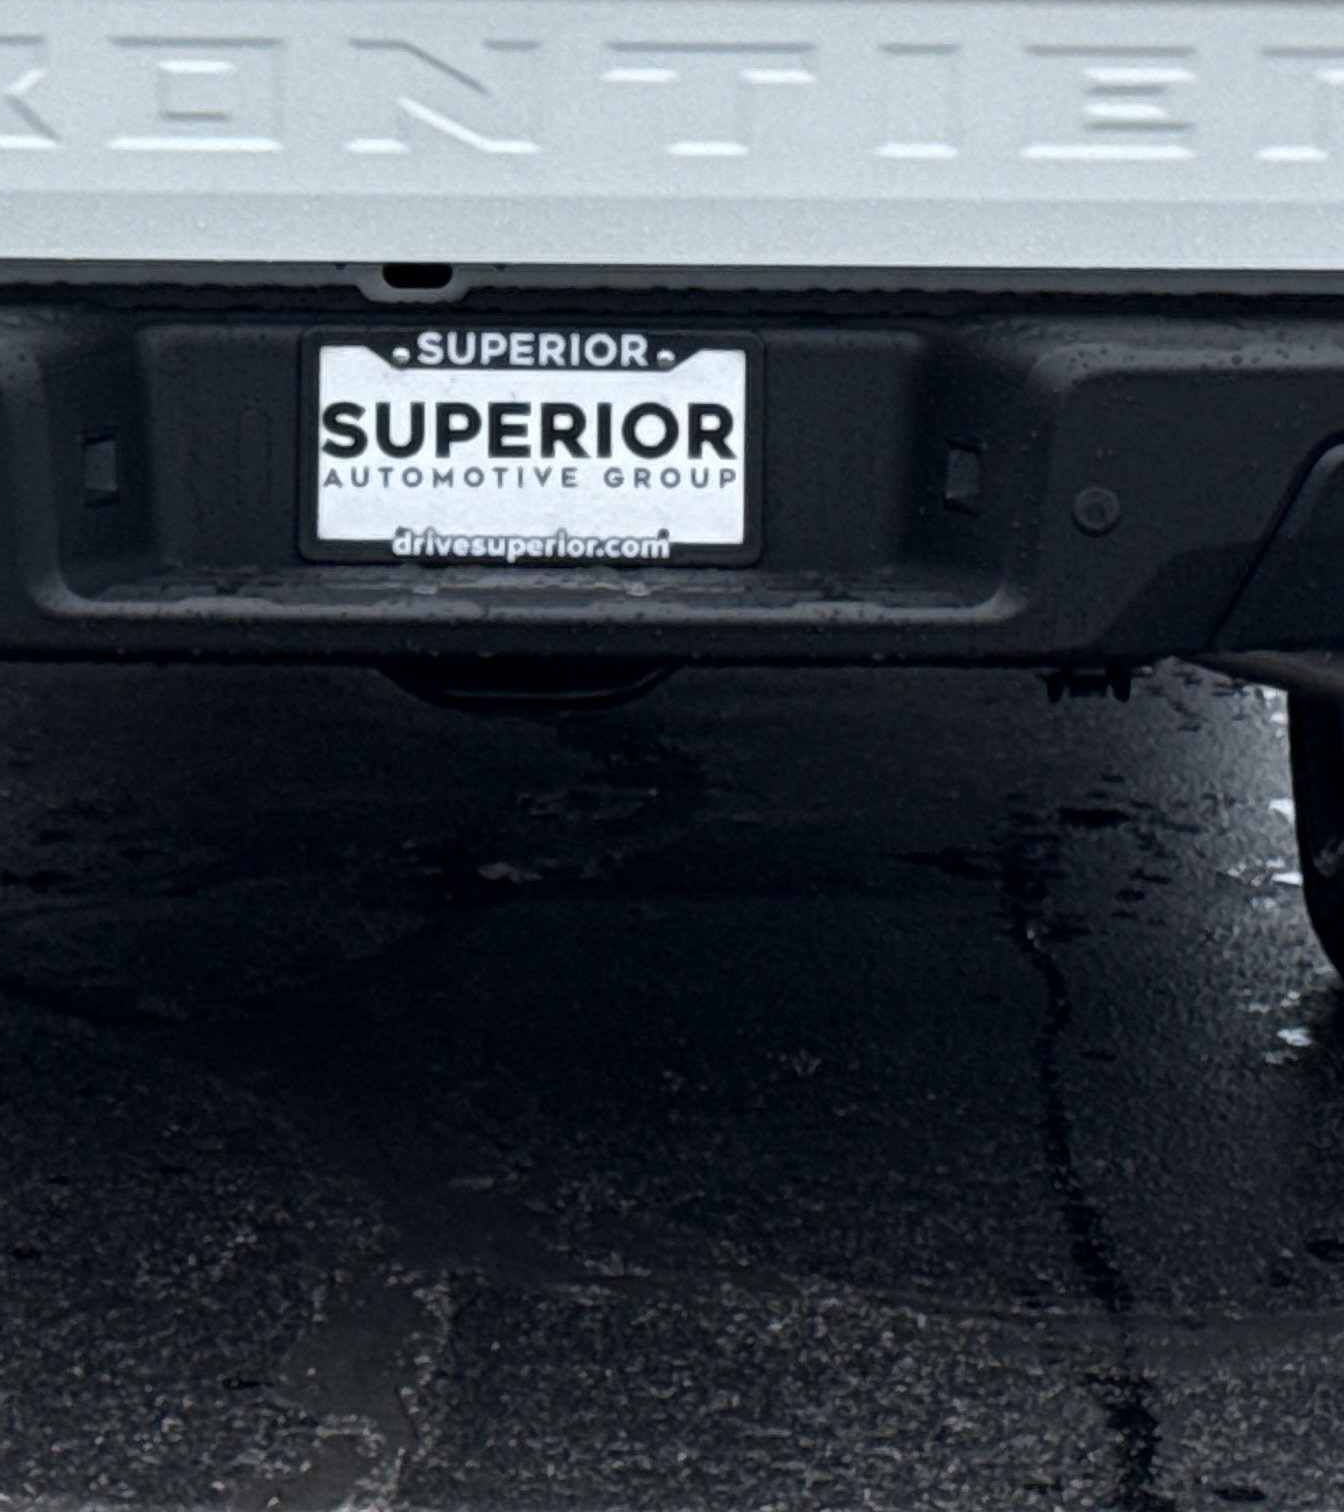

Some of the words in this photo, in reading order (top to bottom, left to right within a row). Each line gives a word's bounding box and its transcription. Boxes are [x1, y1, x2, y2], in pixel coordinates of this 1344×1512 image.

[416, 331, 650, 368] SUPERIOR
[321, 401, 738, 460] SUPERIOR
[323, 466, 580, 489] AUTOMOTIVE
[604, 466, 738, 490] GROUP
[391, 528, 671, 564] drivesuperior.com
